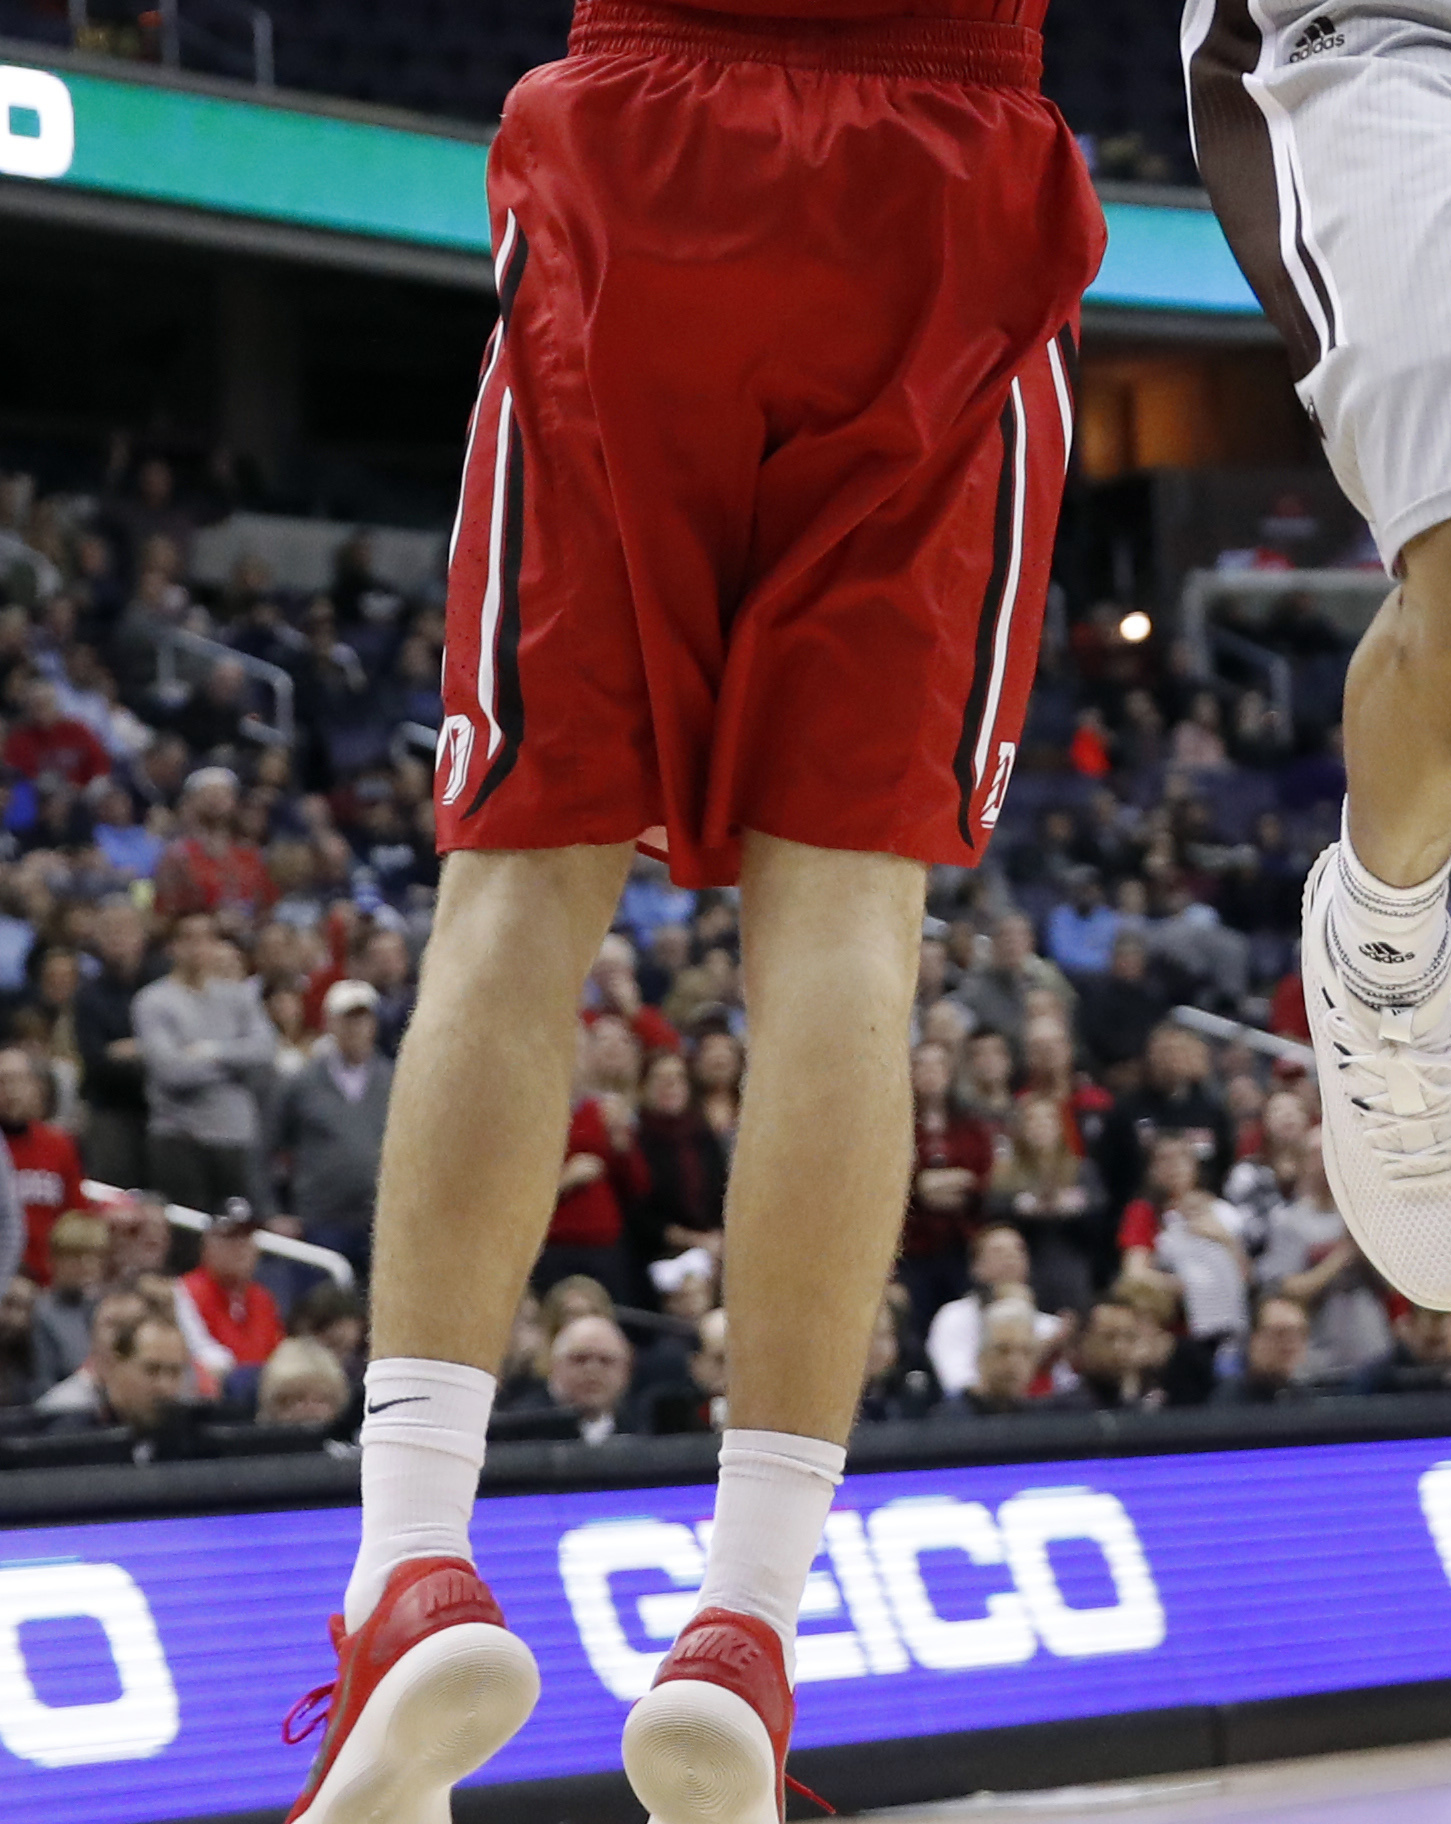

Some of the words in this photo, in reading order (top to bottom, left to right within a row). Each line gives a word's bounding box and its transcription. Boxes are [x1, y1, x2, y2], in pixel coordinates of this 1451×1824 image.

[1289, 33, 1345, 64] adidas
[557, 1484, 1167, 1702] GEICO
[672, 1628, 762, 1671] NIKE
